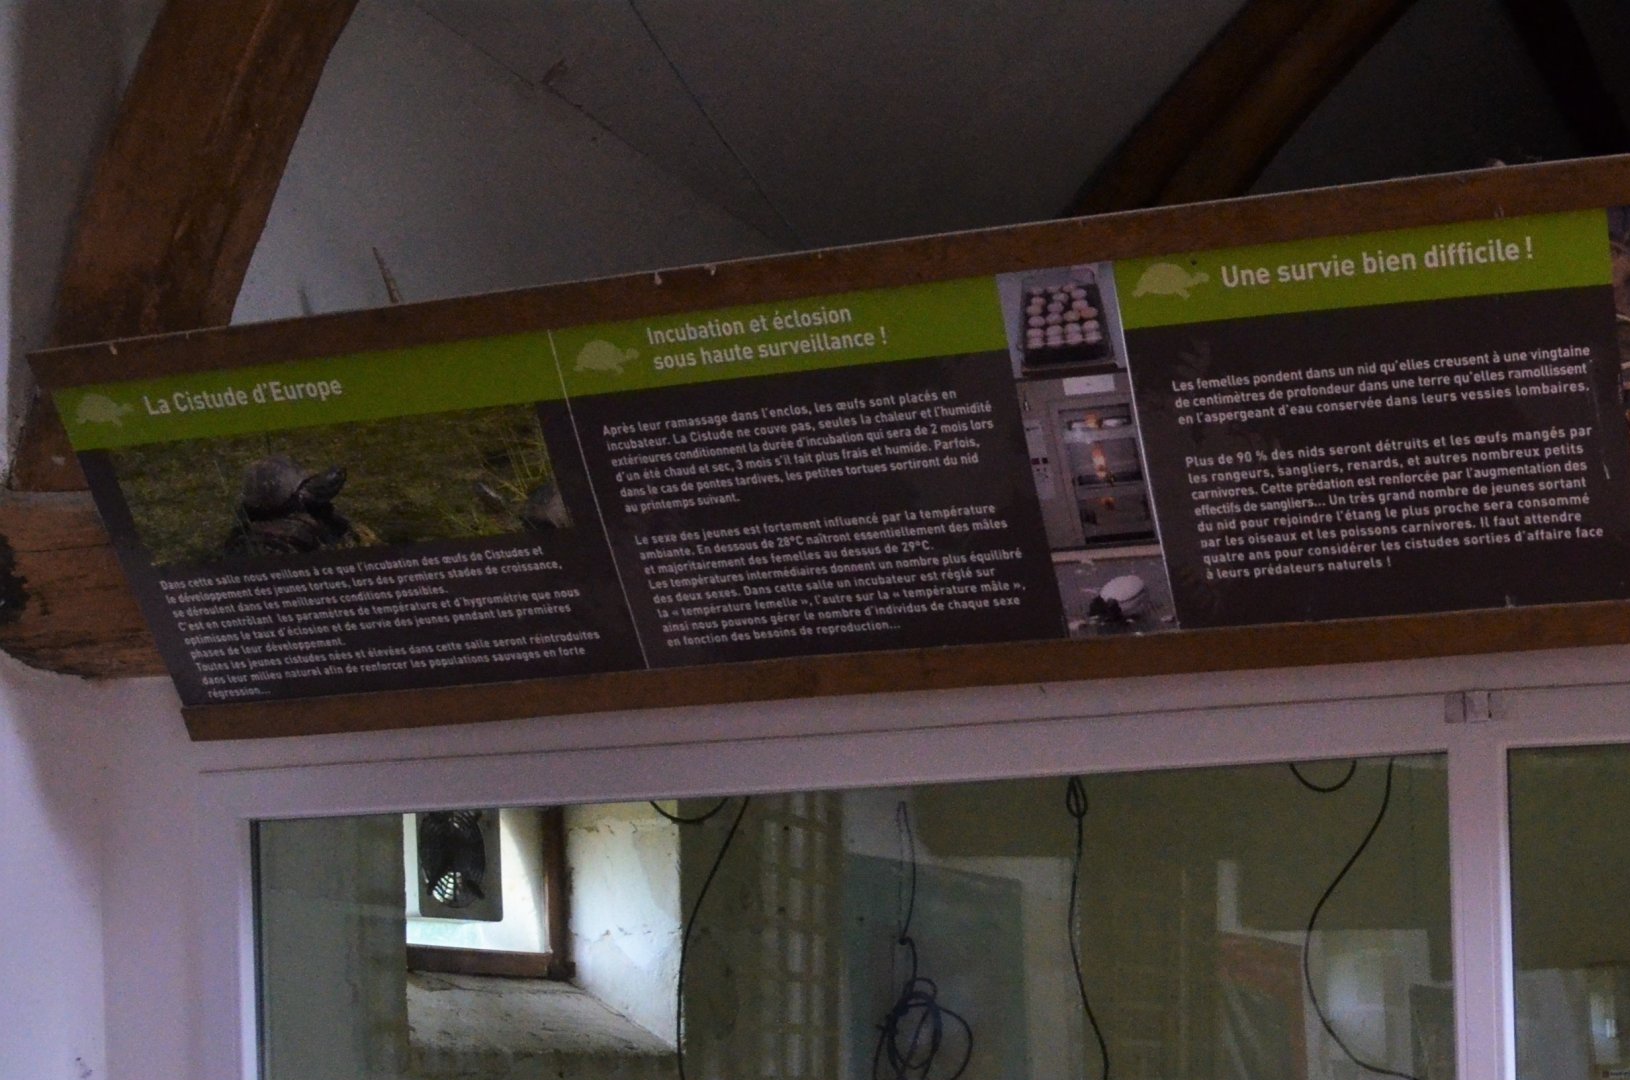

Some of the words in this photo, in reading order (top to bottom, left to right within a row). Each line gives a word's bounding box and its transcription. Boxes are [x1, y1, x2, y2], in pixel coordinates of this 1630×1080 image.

[1220, 265, 1271, 288] Une
[1277, 254, 1355, 284] survie
[1361, 250, 1417, 275] bien
[1423, 239, 1520, 269] difficile
[1524, 236, 1534, 259] !
[646, 318, 746, 345] Incubation
[749, 315, 769, 334] et
[773, 306, 852, 331] éclosion
[653, 350, 697, 371] sous
[699, 343, 754, 366] haute
[758, 330, 875, 358] surveillance
[878, 326, 888, 345] !
[1171, 379, 1194, 390] Les
[1195, 374, 1250, 388] femelles
[1252, 369, 1303, 386] pondent
[1305, 367, 1335, 378] dans
[1338, 367, 1354, 376] un
[1357, 362, 1377, 374] nid
[1433, 353, 1489, 367] creusent
[1491, 351, 1500, 362] à
[1503, 351, 1527, 361] une
[1530, 344, 1590, 360] vingtaine
[143, 395, 171, 416] La
[172, 386, 249, 413] Cistude
[252, 378, 343, 403] d'Europe
[1193, 501, 1241, 514] effectifs
[1242, 500, 1258, 511] de
[1328, 494, 1346, 505] Un
[1348, 492, 1375, 503] très
[1377, 488, 1415, 504] grand
[1418, 485, 1468, 498] nombre
[1471, 483, 1488, 494] de
[1490, 482, 1534, 495] jeunes
[1538, 476, 1586, 489] sortant
